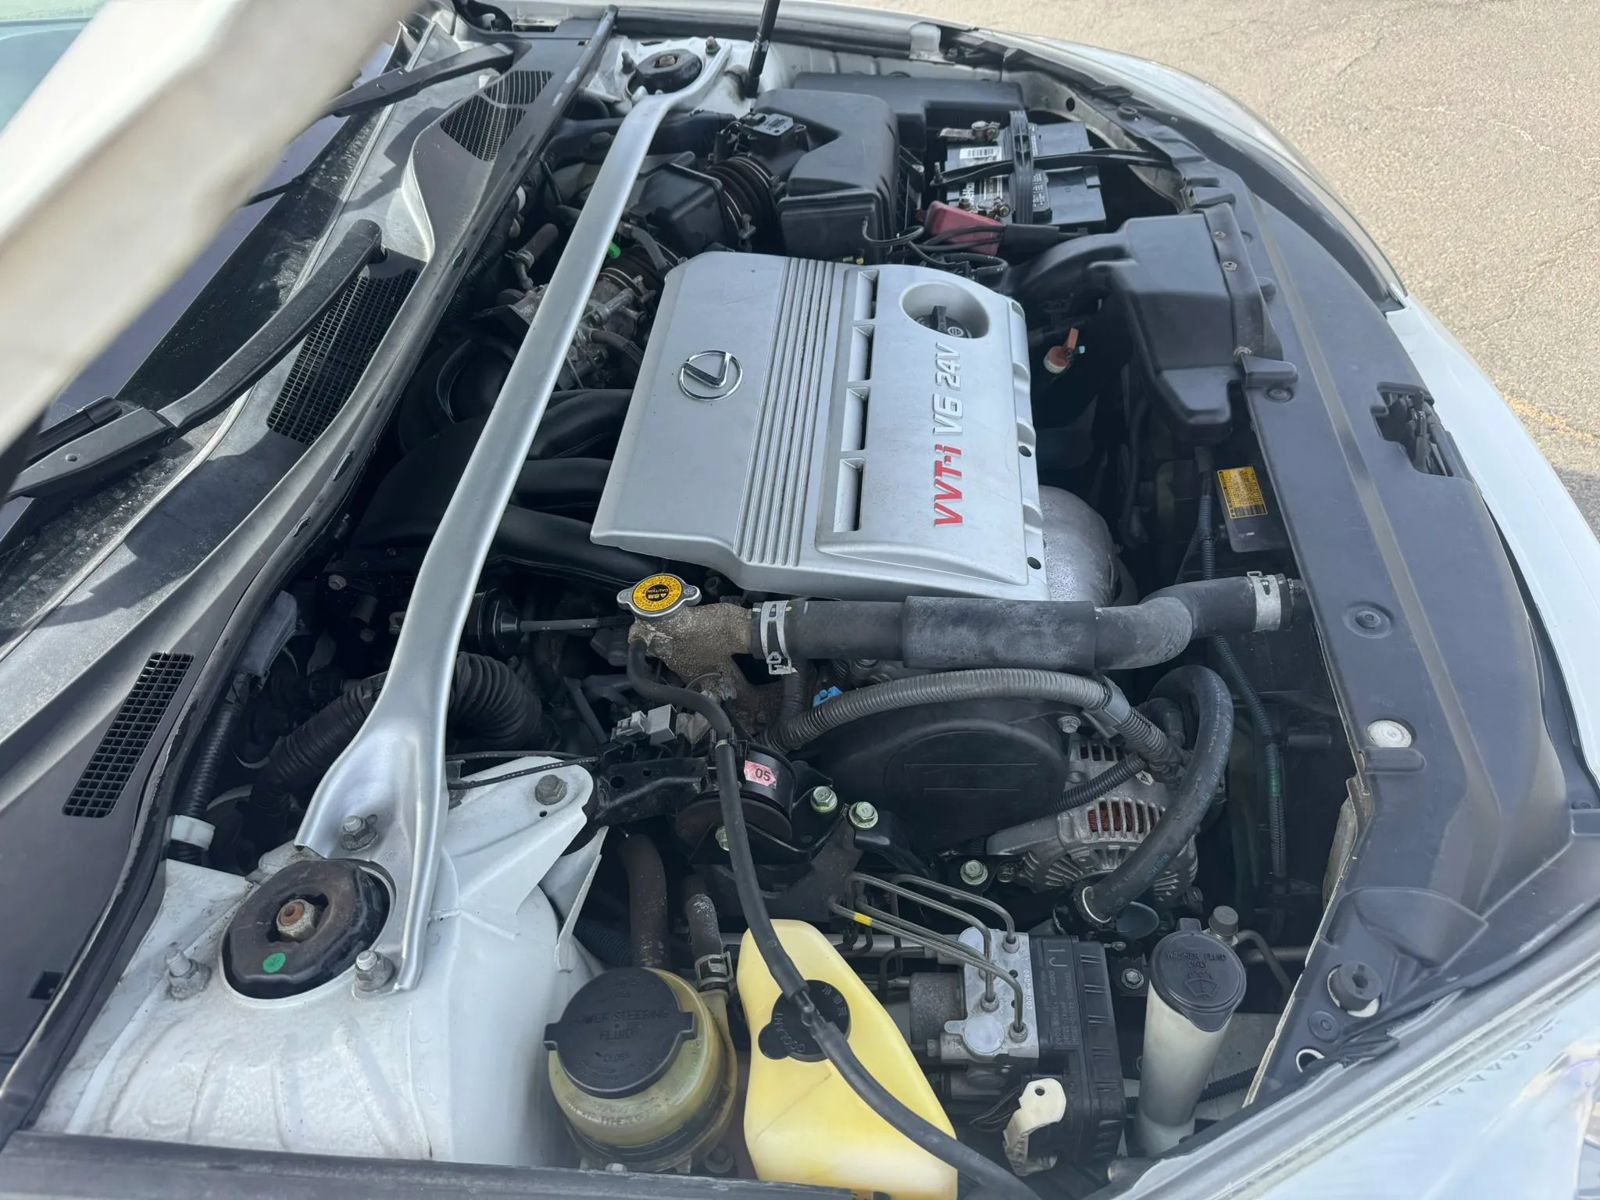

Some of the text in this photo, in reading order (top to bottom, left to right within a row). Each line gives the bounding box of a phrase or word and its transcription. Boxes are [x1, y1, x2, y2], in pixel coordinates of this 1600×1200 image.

[933, 342, 963, 527] VVT-i V6 24V
[755, 768, 771, 782] 05
